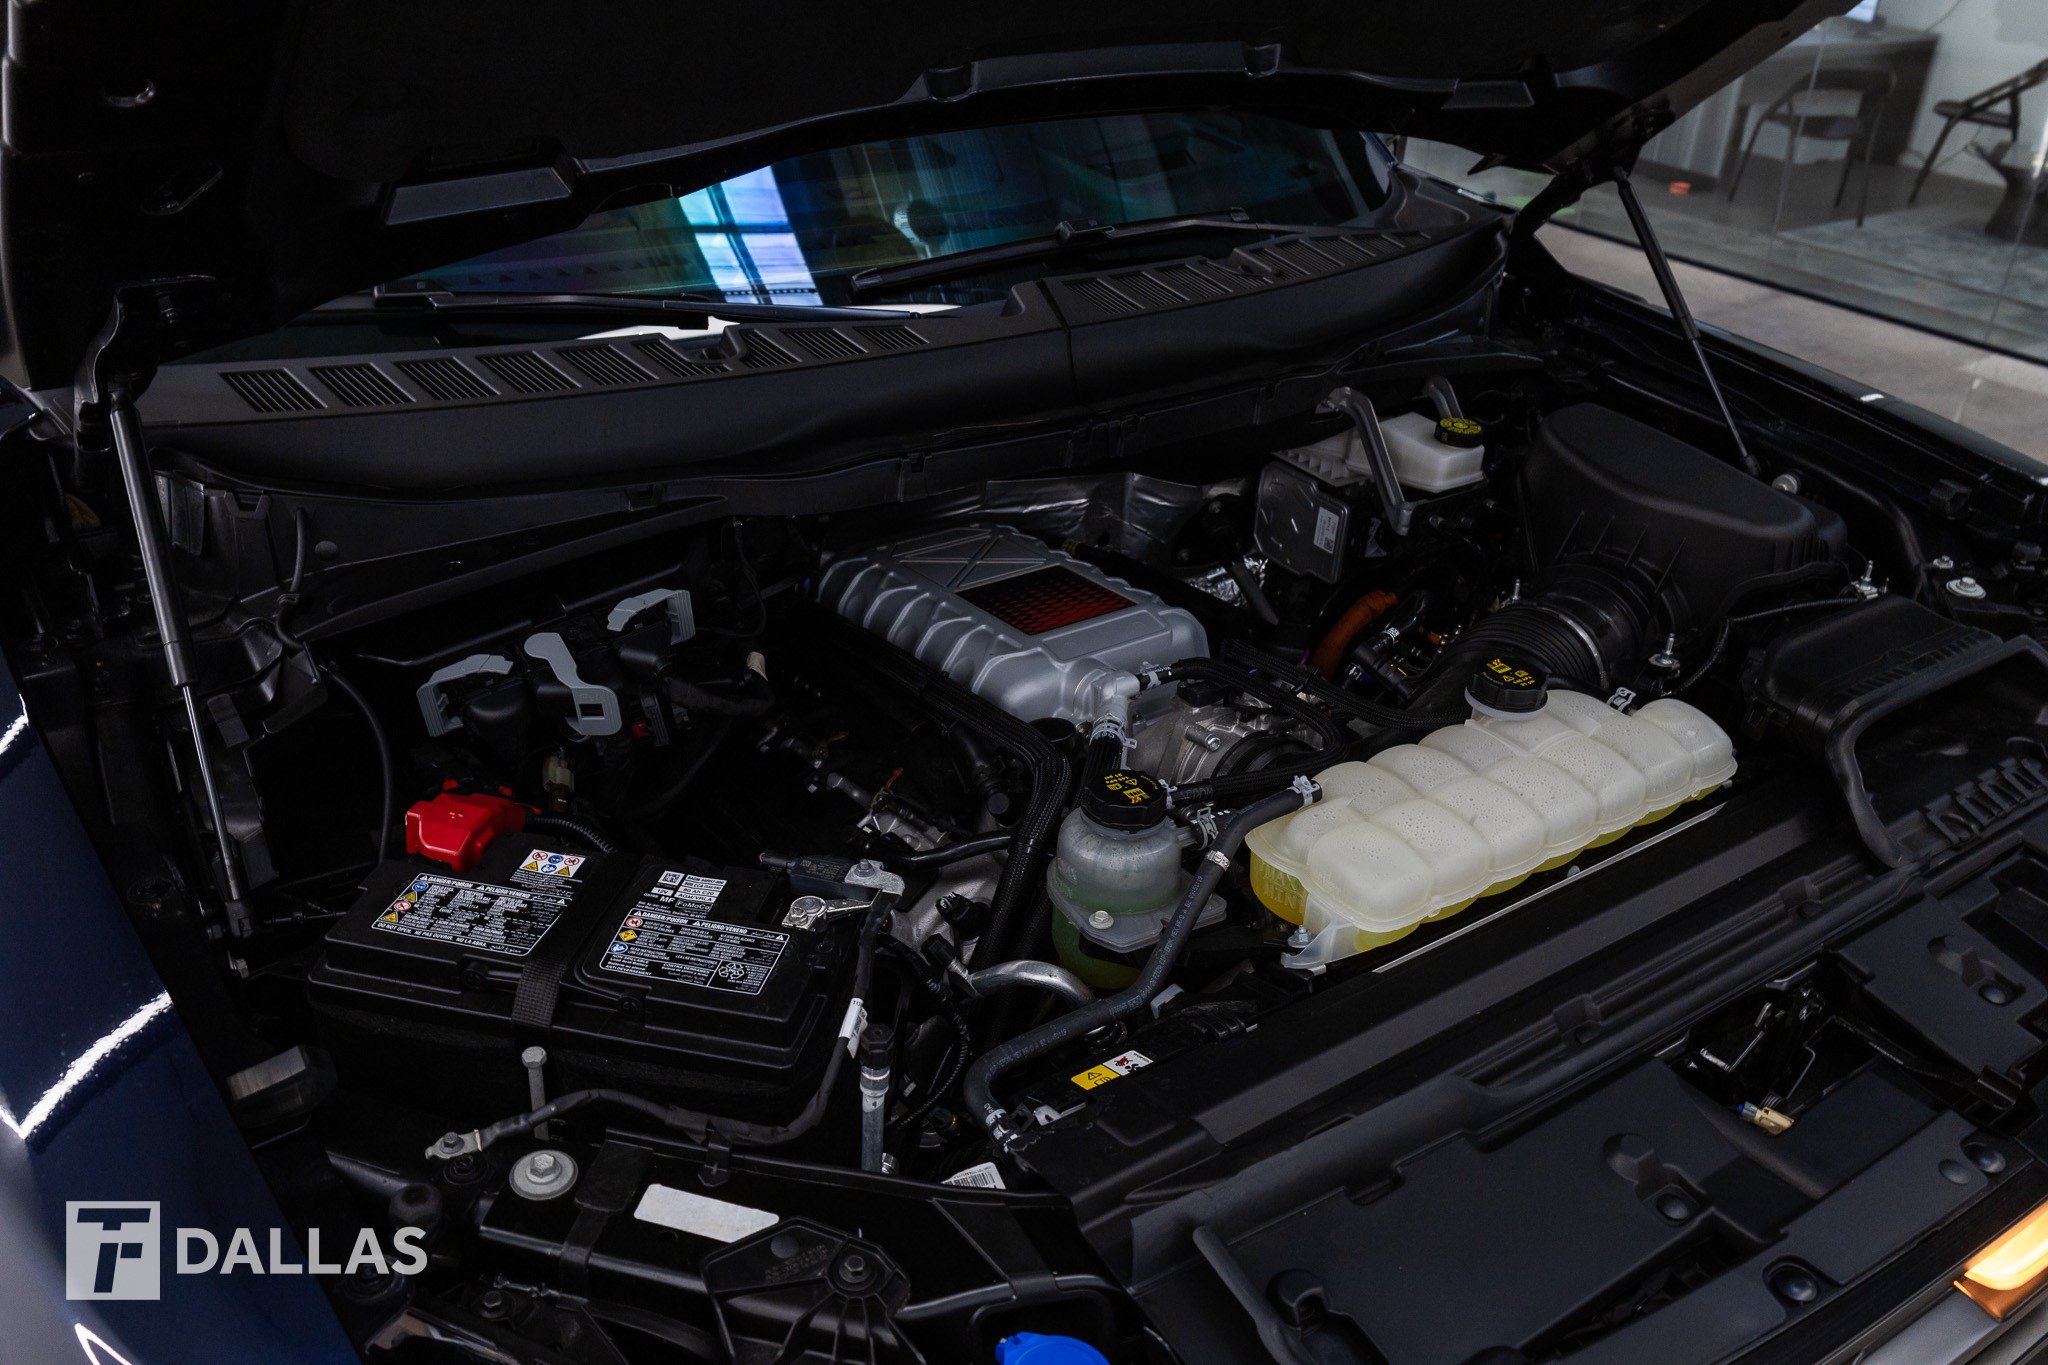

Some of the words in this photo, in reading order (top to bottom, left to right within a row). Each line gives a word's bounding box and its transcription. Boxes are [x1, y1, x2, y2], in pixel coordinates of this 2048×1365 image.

[676, 900, 710, 910] FoMoCo
[642, 912, 688, 924] DANGER/POISON
[702, 922, 748, 934] PELIGRO/VENENO
